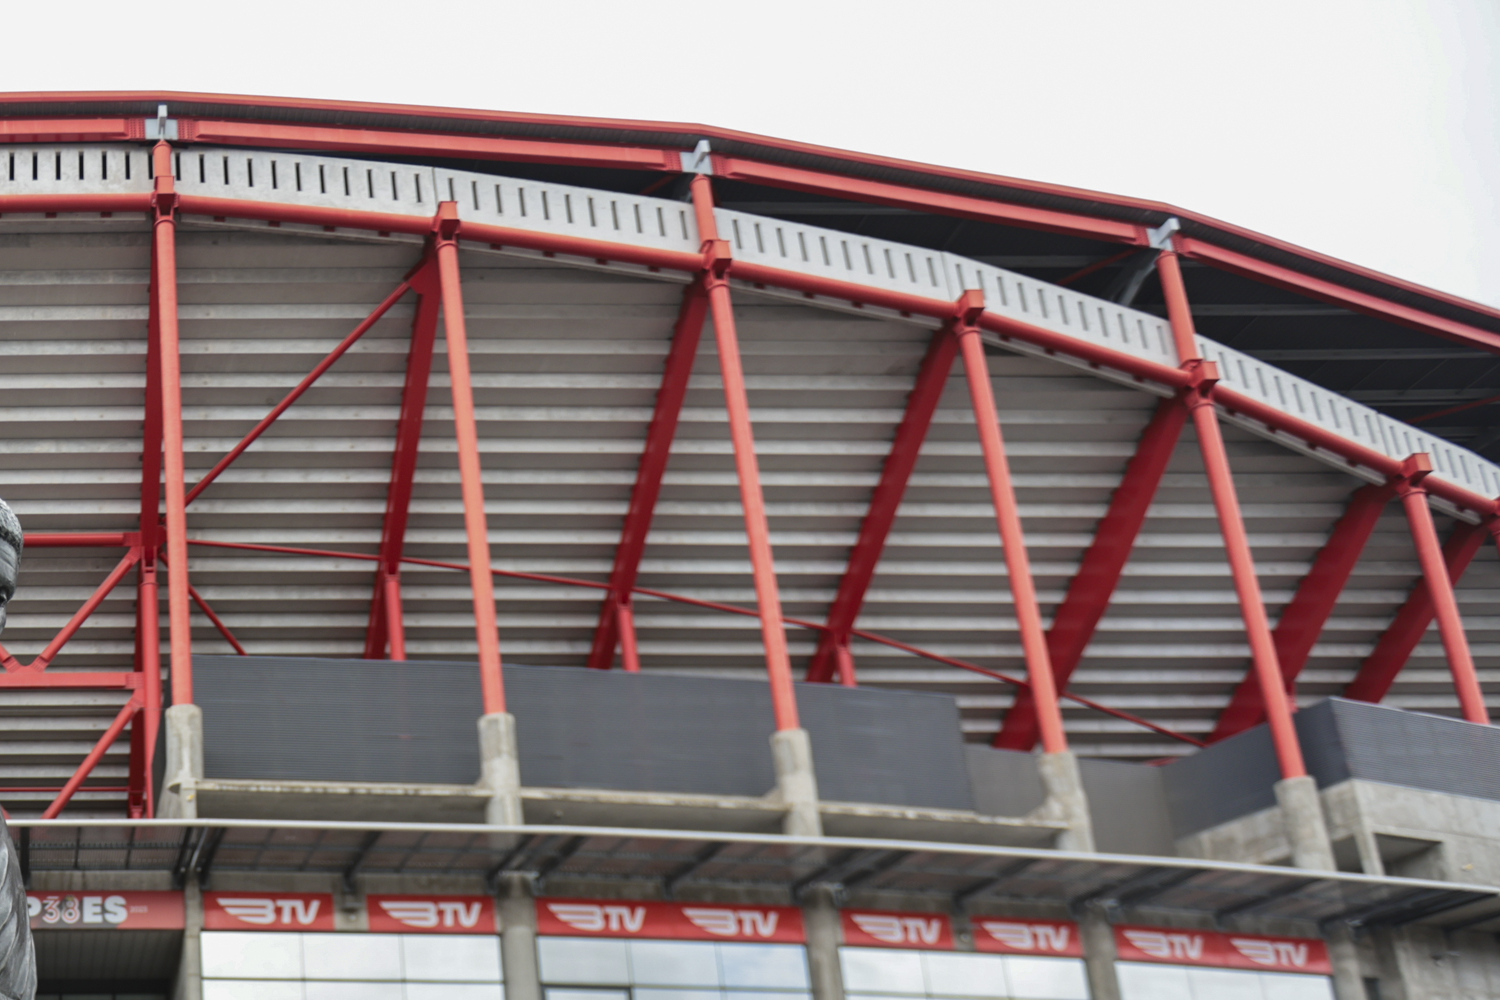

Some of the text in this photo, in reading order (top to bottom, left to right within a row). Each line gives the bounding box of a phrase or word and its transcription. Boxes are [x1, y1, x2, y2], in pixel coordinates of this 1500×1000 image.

[216, 897, 320, 925] BTV
[379, 901, 482, 928] BTV
[547, 903, 647, 932] BTV
[681, 907, 779, 937] BTV
[851, 914, 942, 945] BTV
[981, 921, 1071, 952] BTV
[1122, 930, 1203, 961] BTV
[1229, 937, 1309, 968] BTV
